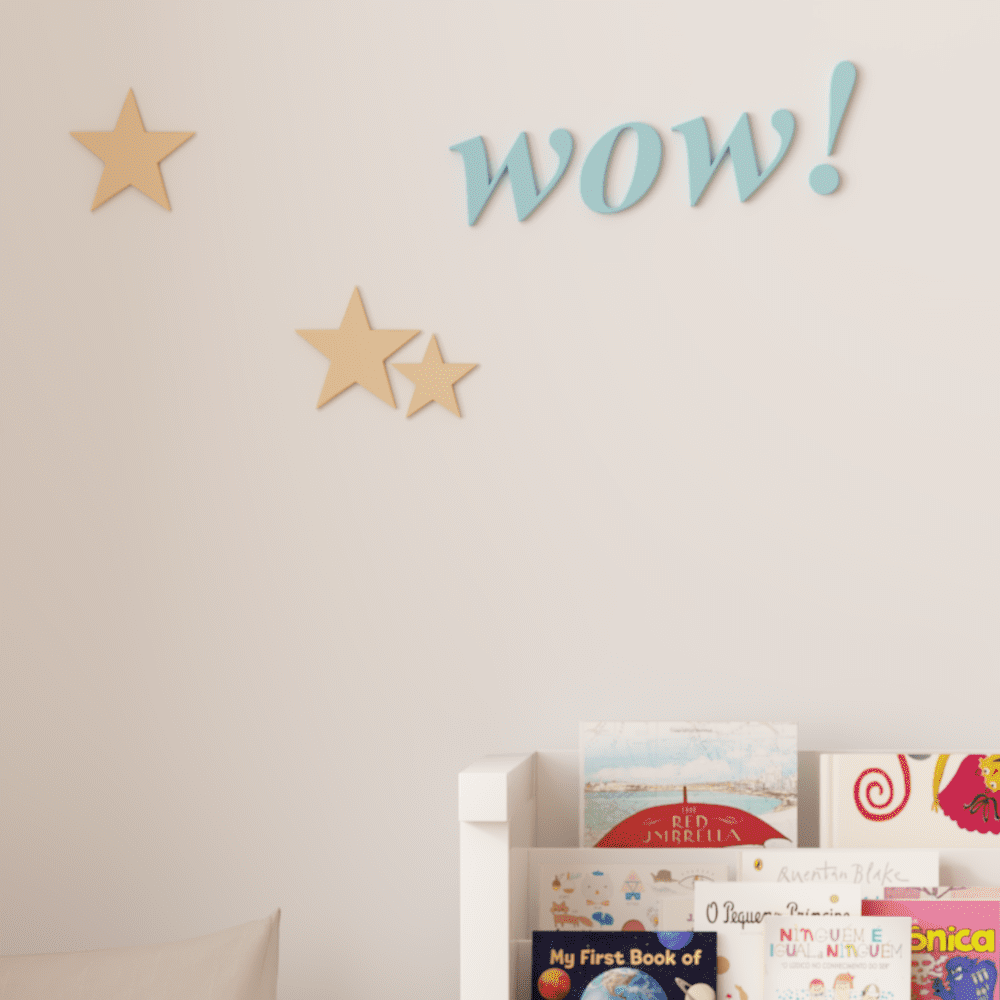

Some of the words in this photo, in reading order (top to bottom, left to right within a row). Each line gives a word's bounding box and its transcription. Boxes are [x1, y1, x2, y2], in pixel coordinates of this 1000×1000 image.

[449, 60, 857, 227] wow!
[672, 815, 708, 829] RED
[851, 861, 909, 886] Blake
[706, 901, 719, 924] O
[550, 949, 575, 969] My
[580, 949, 625, 965] First
[630, 949, 676, 965] Book
[681, 949, 702, 965] of
